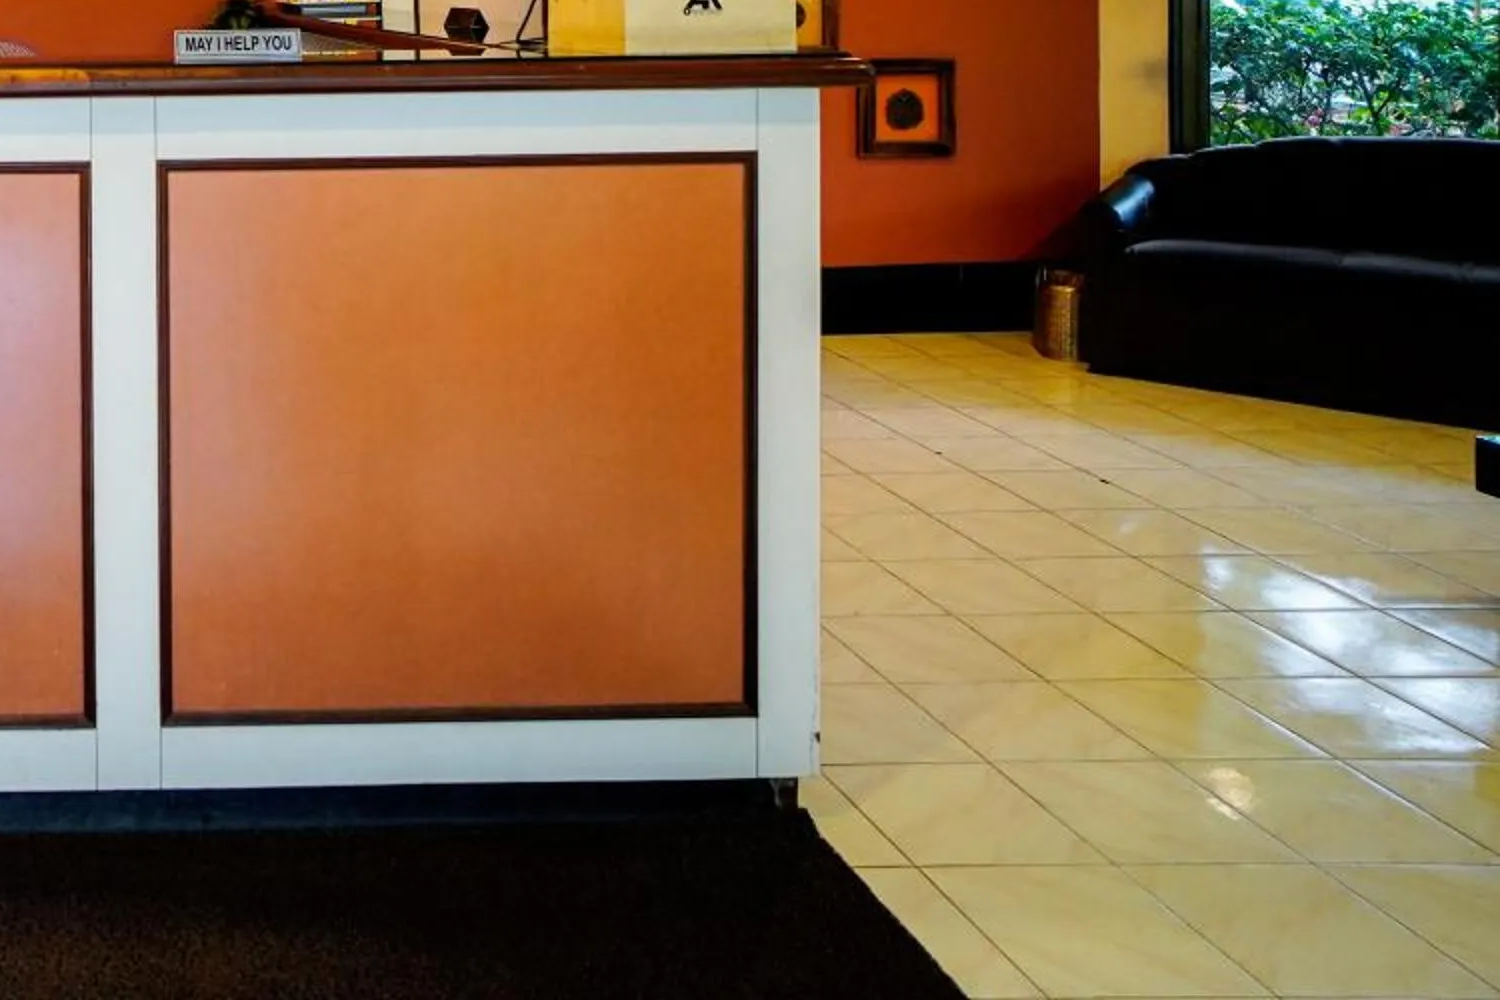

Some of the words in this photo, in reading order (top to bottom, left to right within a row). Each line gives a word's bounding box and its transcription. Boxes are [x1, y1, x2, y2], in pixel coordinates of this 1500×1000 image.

[185, 36, 213, 51] MAY
[225, 36, 259, 51] HELP
[262, 35, 292, 51] YOU
